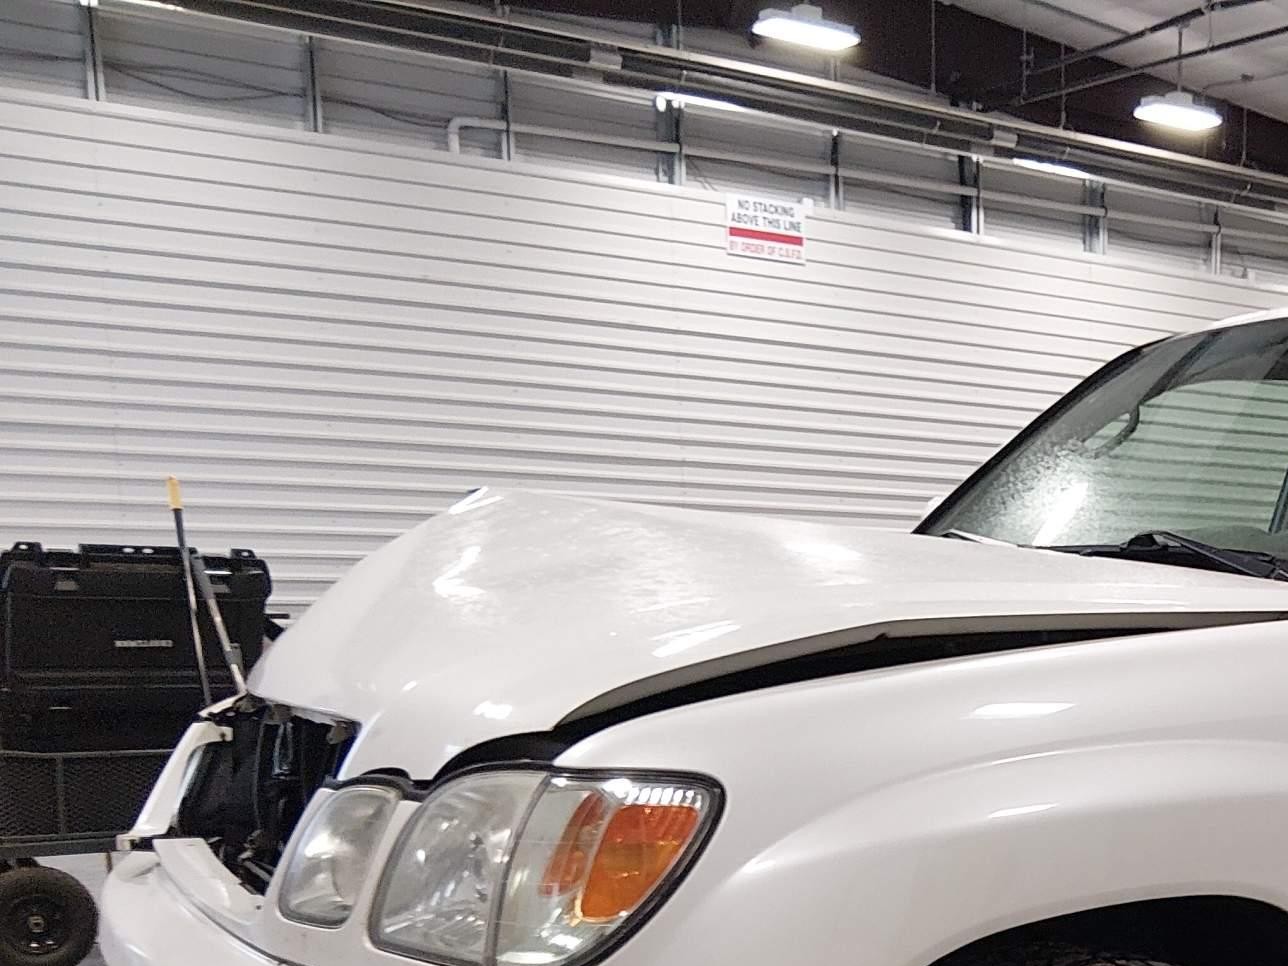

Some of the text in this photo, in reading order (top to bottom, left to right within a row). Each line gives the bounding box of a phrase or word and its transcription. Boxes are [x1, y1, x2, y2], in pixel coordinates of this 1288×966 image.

[738, 200, 795, 217] NO STACKING
[731, 211, 802, 234] ABOVE THIS LINE
[741, 242, 765, 254] ORDER
